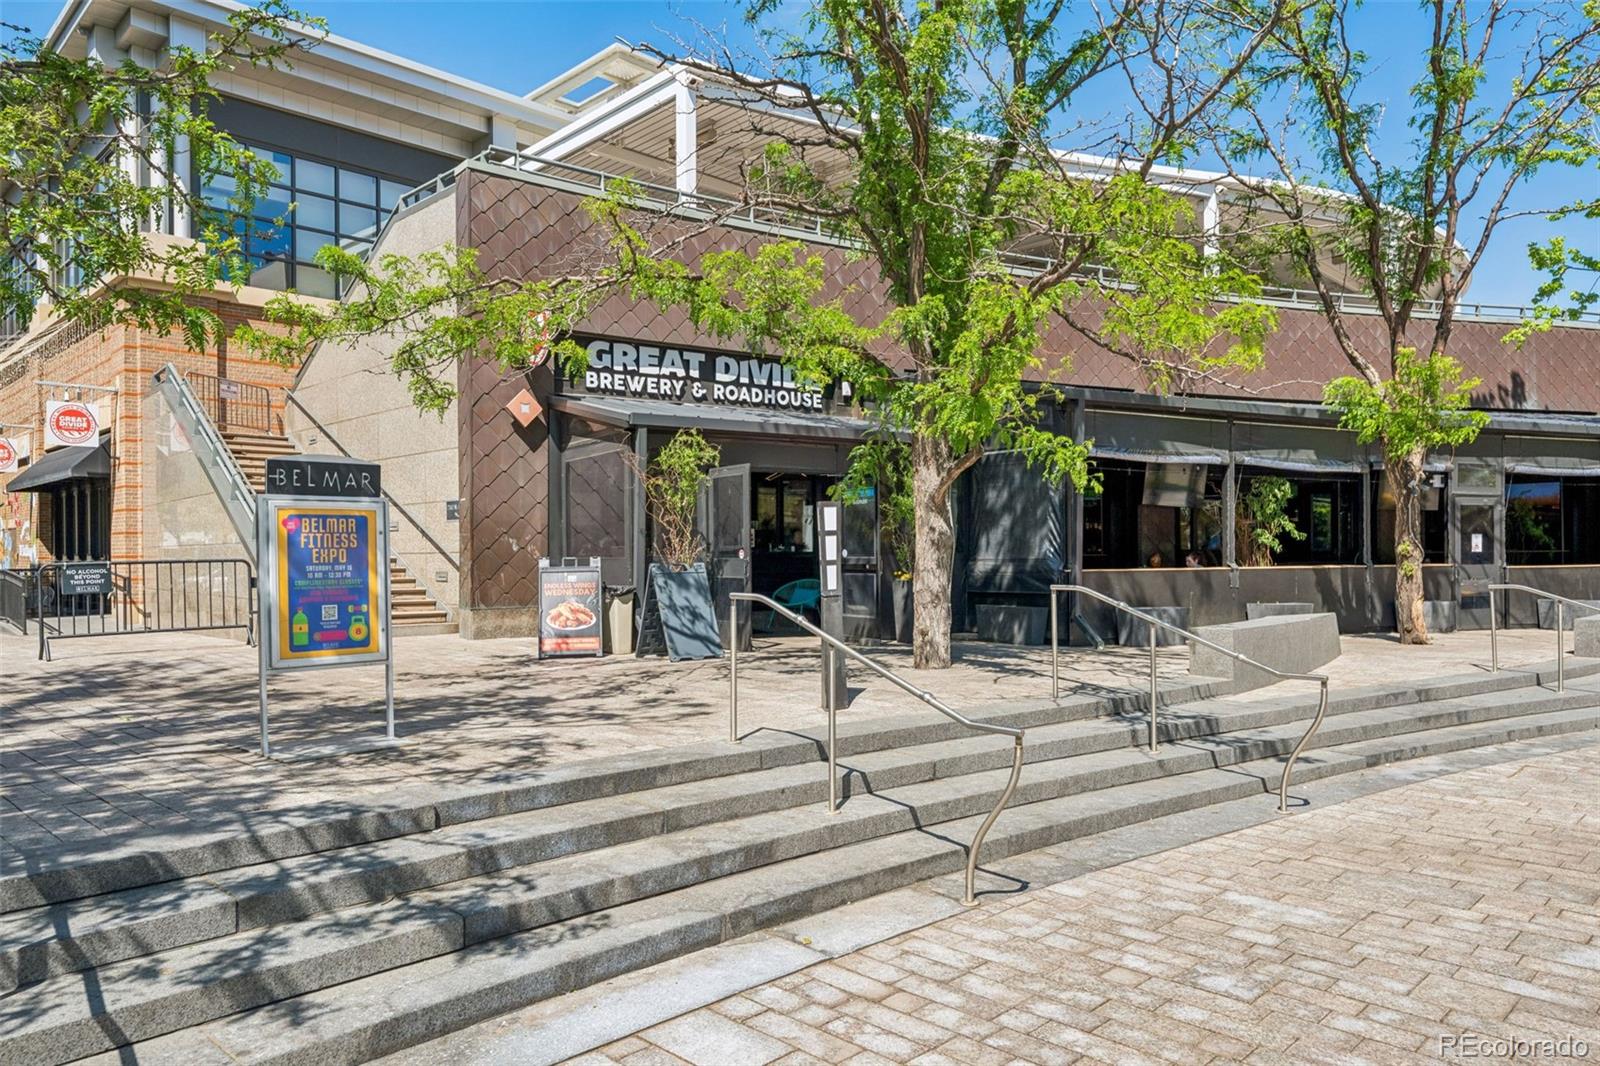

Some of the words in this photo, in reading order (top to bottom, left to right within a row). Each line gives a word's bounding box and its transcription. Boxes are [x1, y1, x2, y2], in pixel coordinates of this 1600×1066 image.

[586, 340, 705, 378] GREAT
[585, 371, 685, 396] BREWERY
[691, 381, 707, 397] &
[713, 383, 822, 408] ROADHOUSE
[269, 464, 375, 494] BELMAR
[301, 518, 357, 533] BELMAR
[300, 533, 358, 549] FITNESS
[312, 548, 347, 564] EXPO
